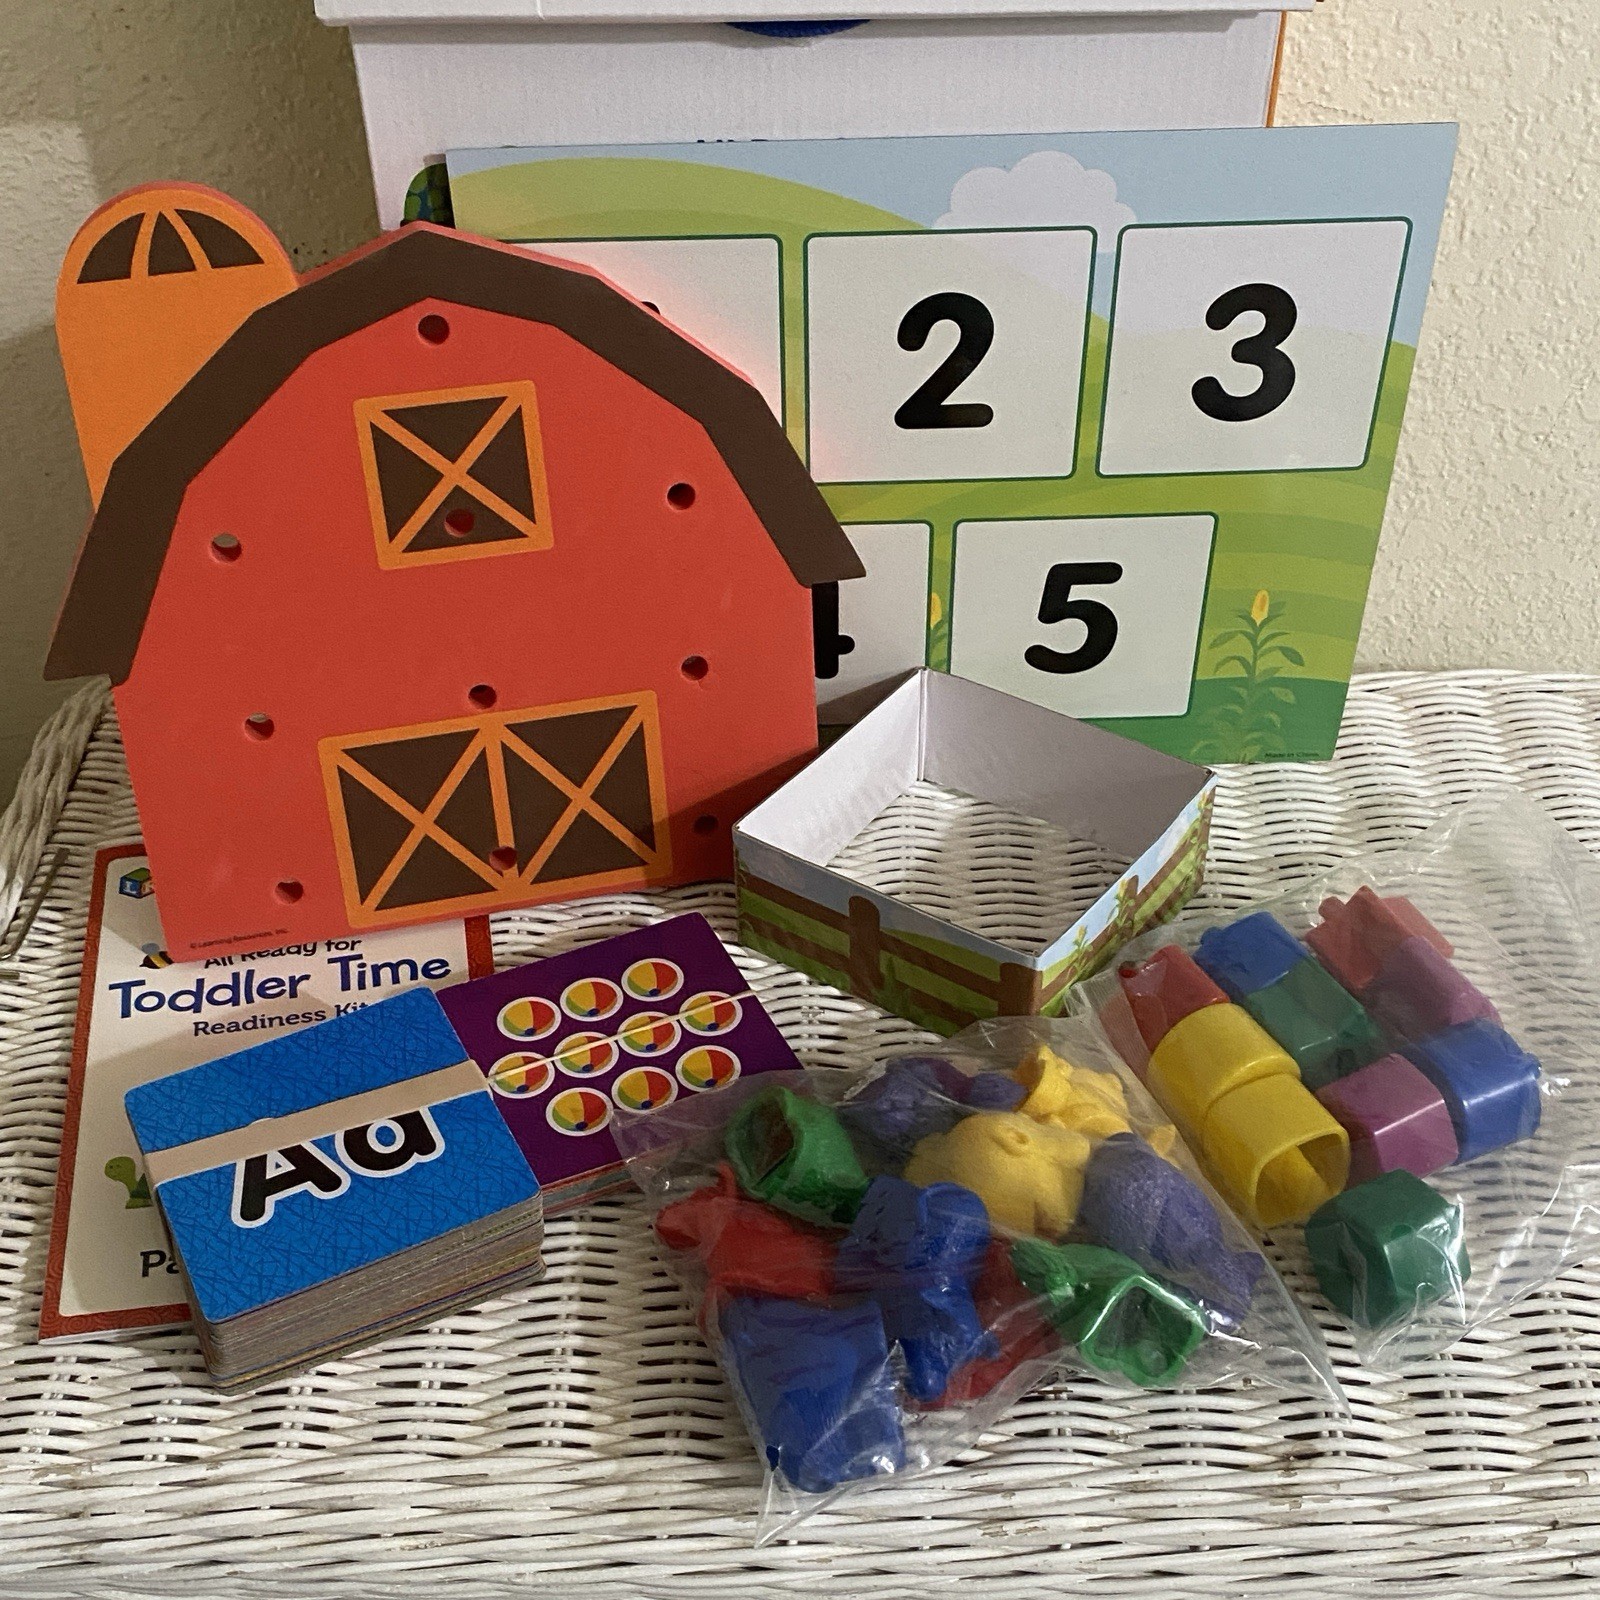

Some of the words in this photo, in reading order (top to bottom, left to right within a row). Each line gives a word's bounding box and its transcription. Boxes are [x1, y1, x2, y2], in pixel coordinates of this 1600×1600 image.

[893, 291, 995, 430] 2
[1190, 282, 1298, 423] 3
[1023, 561, 1124, 675] 5
[108, 968, 312, 1019] Toddler
[327, 953, 452, 992] Time
[325, 938, 362, 952] for
[193, 1009, 327, 1037] Readiness
[235, 1108, 442, 1225] Aa
